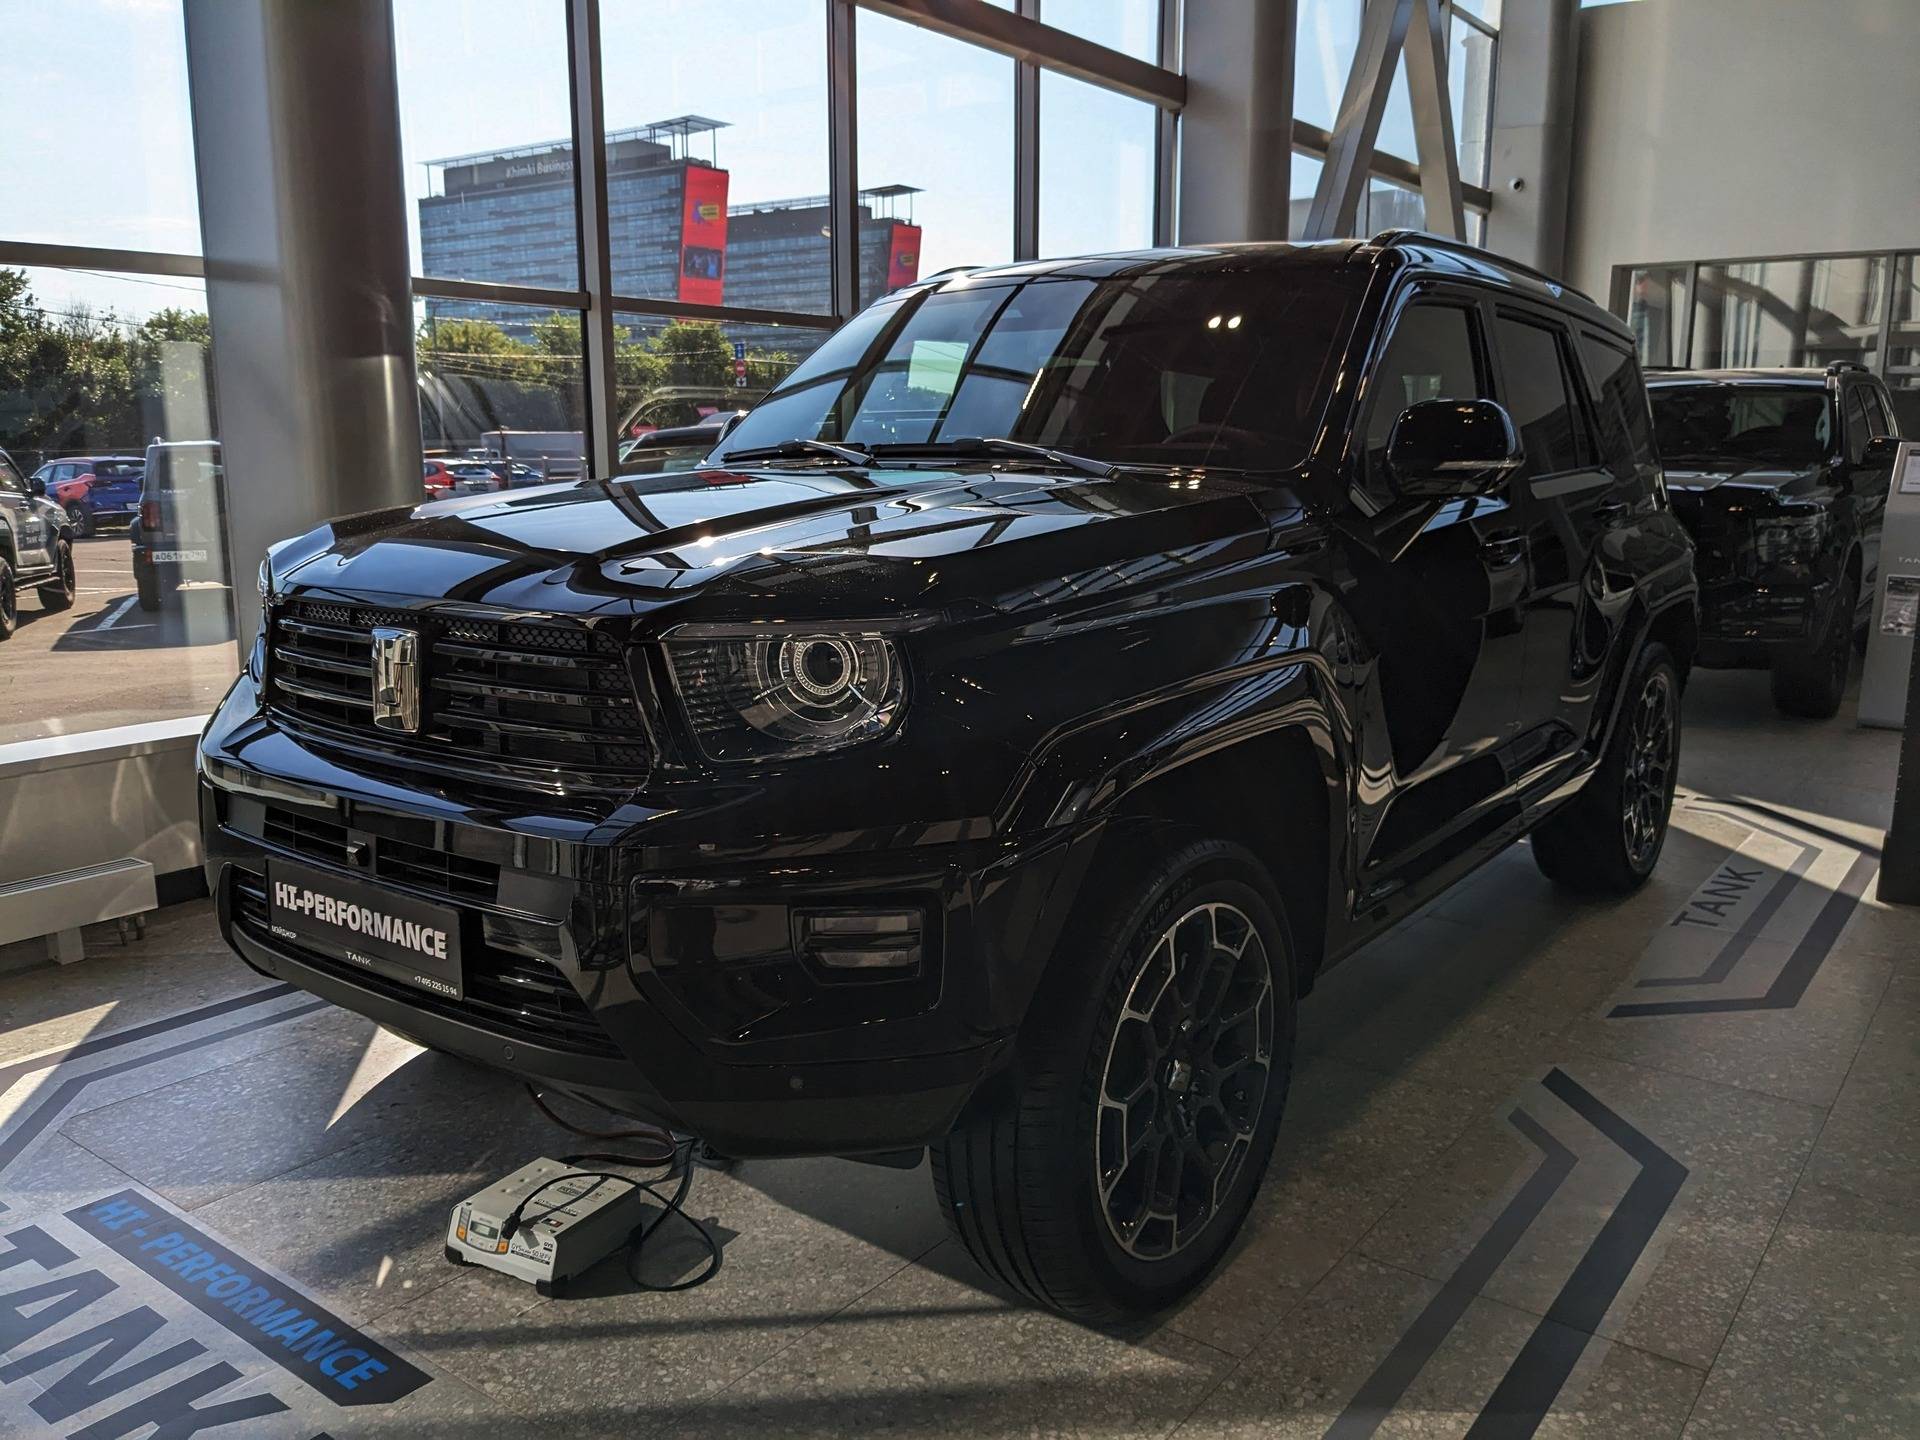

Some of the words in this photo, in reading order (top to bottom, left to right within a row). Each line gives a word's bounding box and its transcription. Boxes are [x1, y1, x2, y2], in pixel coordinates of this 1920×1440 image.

[275, 881, 448, 960] HI-PERFORMANCE
[1670, 866, 1763, 927] TANK
[345, 951, 372, 966] TANK
